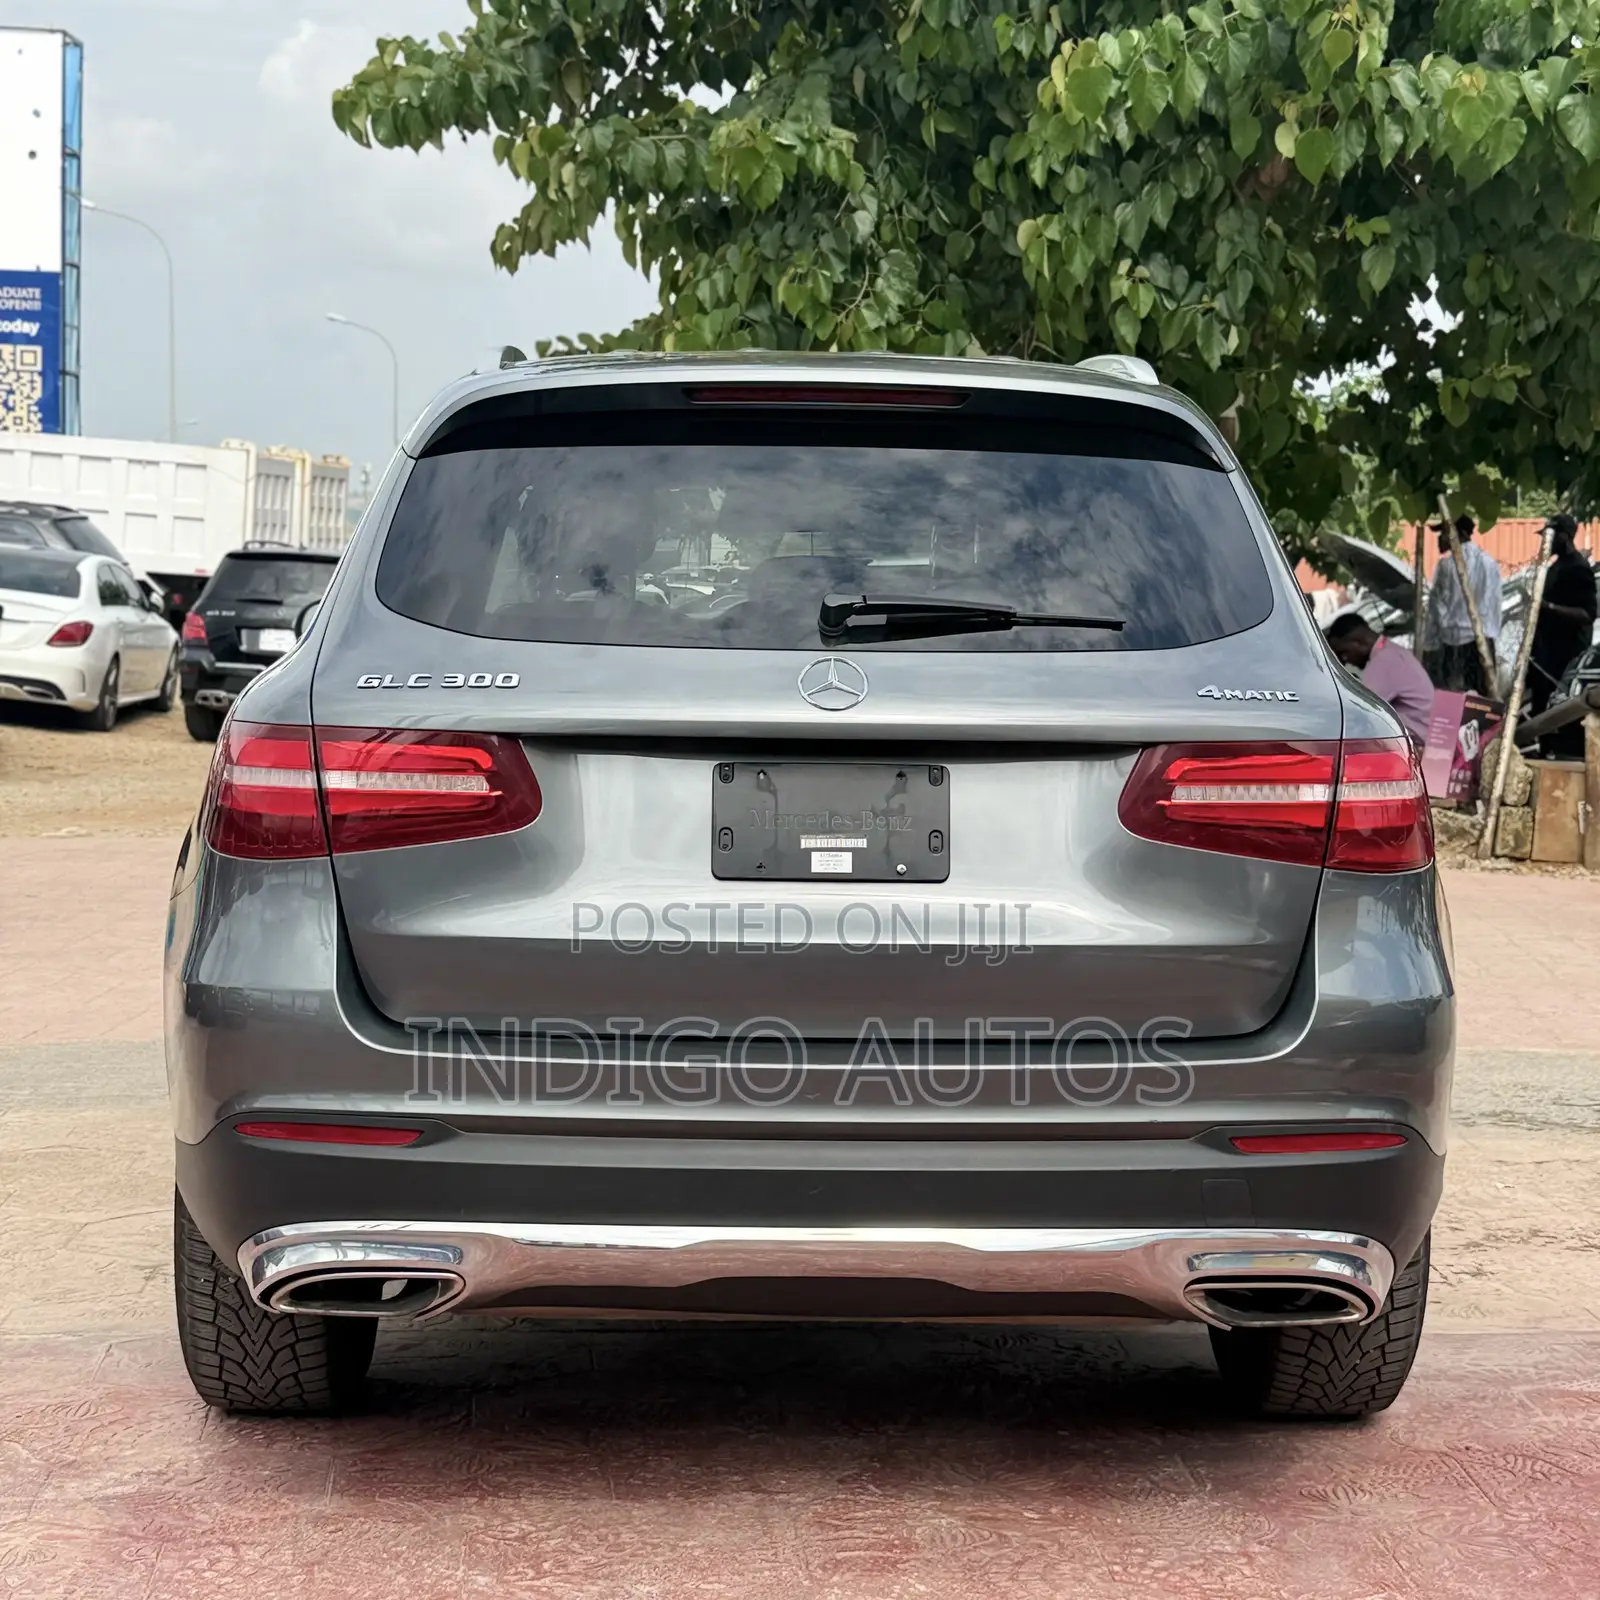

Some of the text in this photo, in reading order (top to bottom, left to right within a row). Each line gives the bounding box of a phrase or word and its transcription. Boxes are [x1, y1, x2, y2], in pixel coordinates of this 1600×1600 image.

[356, 672, 521, 689] GLC 300
[1197, 684, 1300, 702] 4MATIC
[749, 808, 913, 832] Mercedes-Benz
